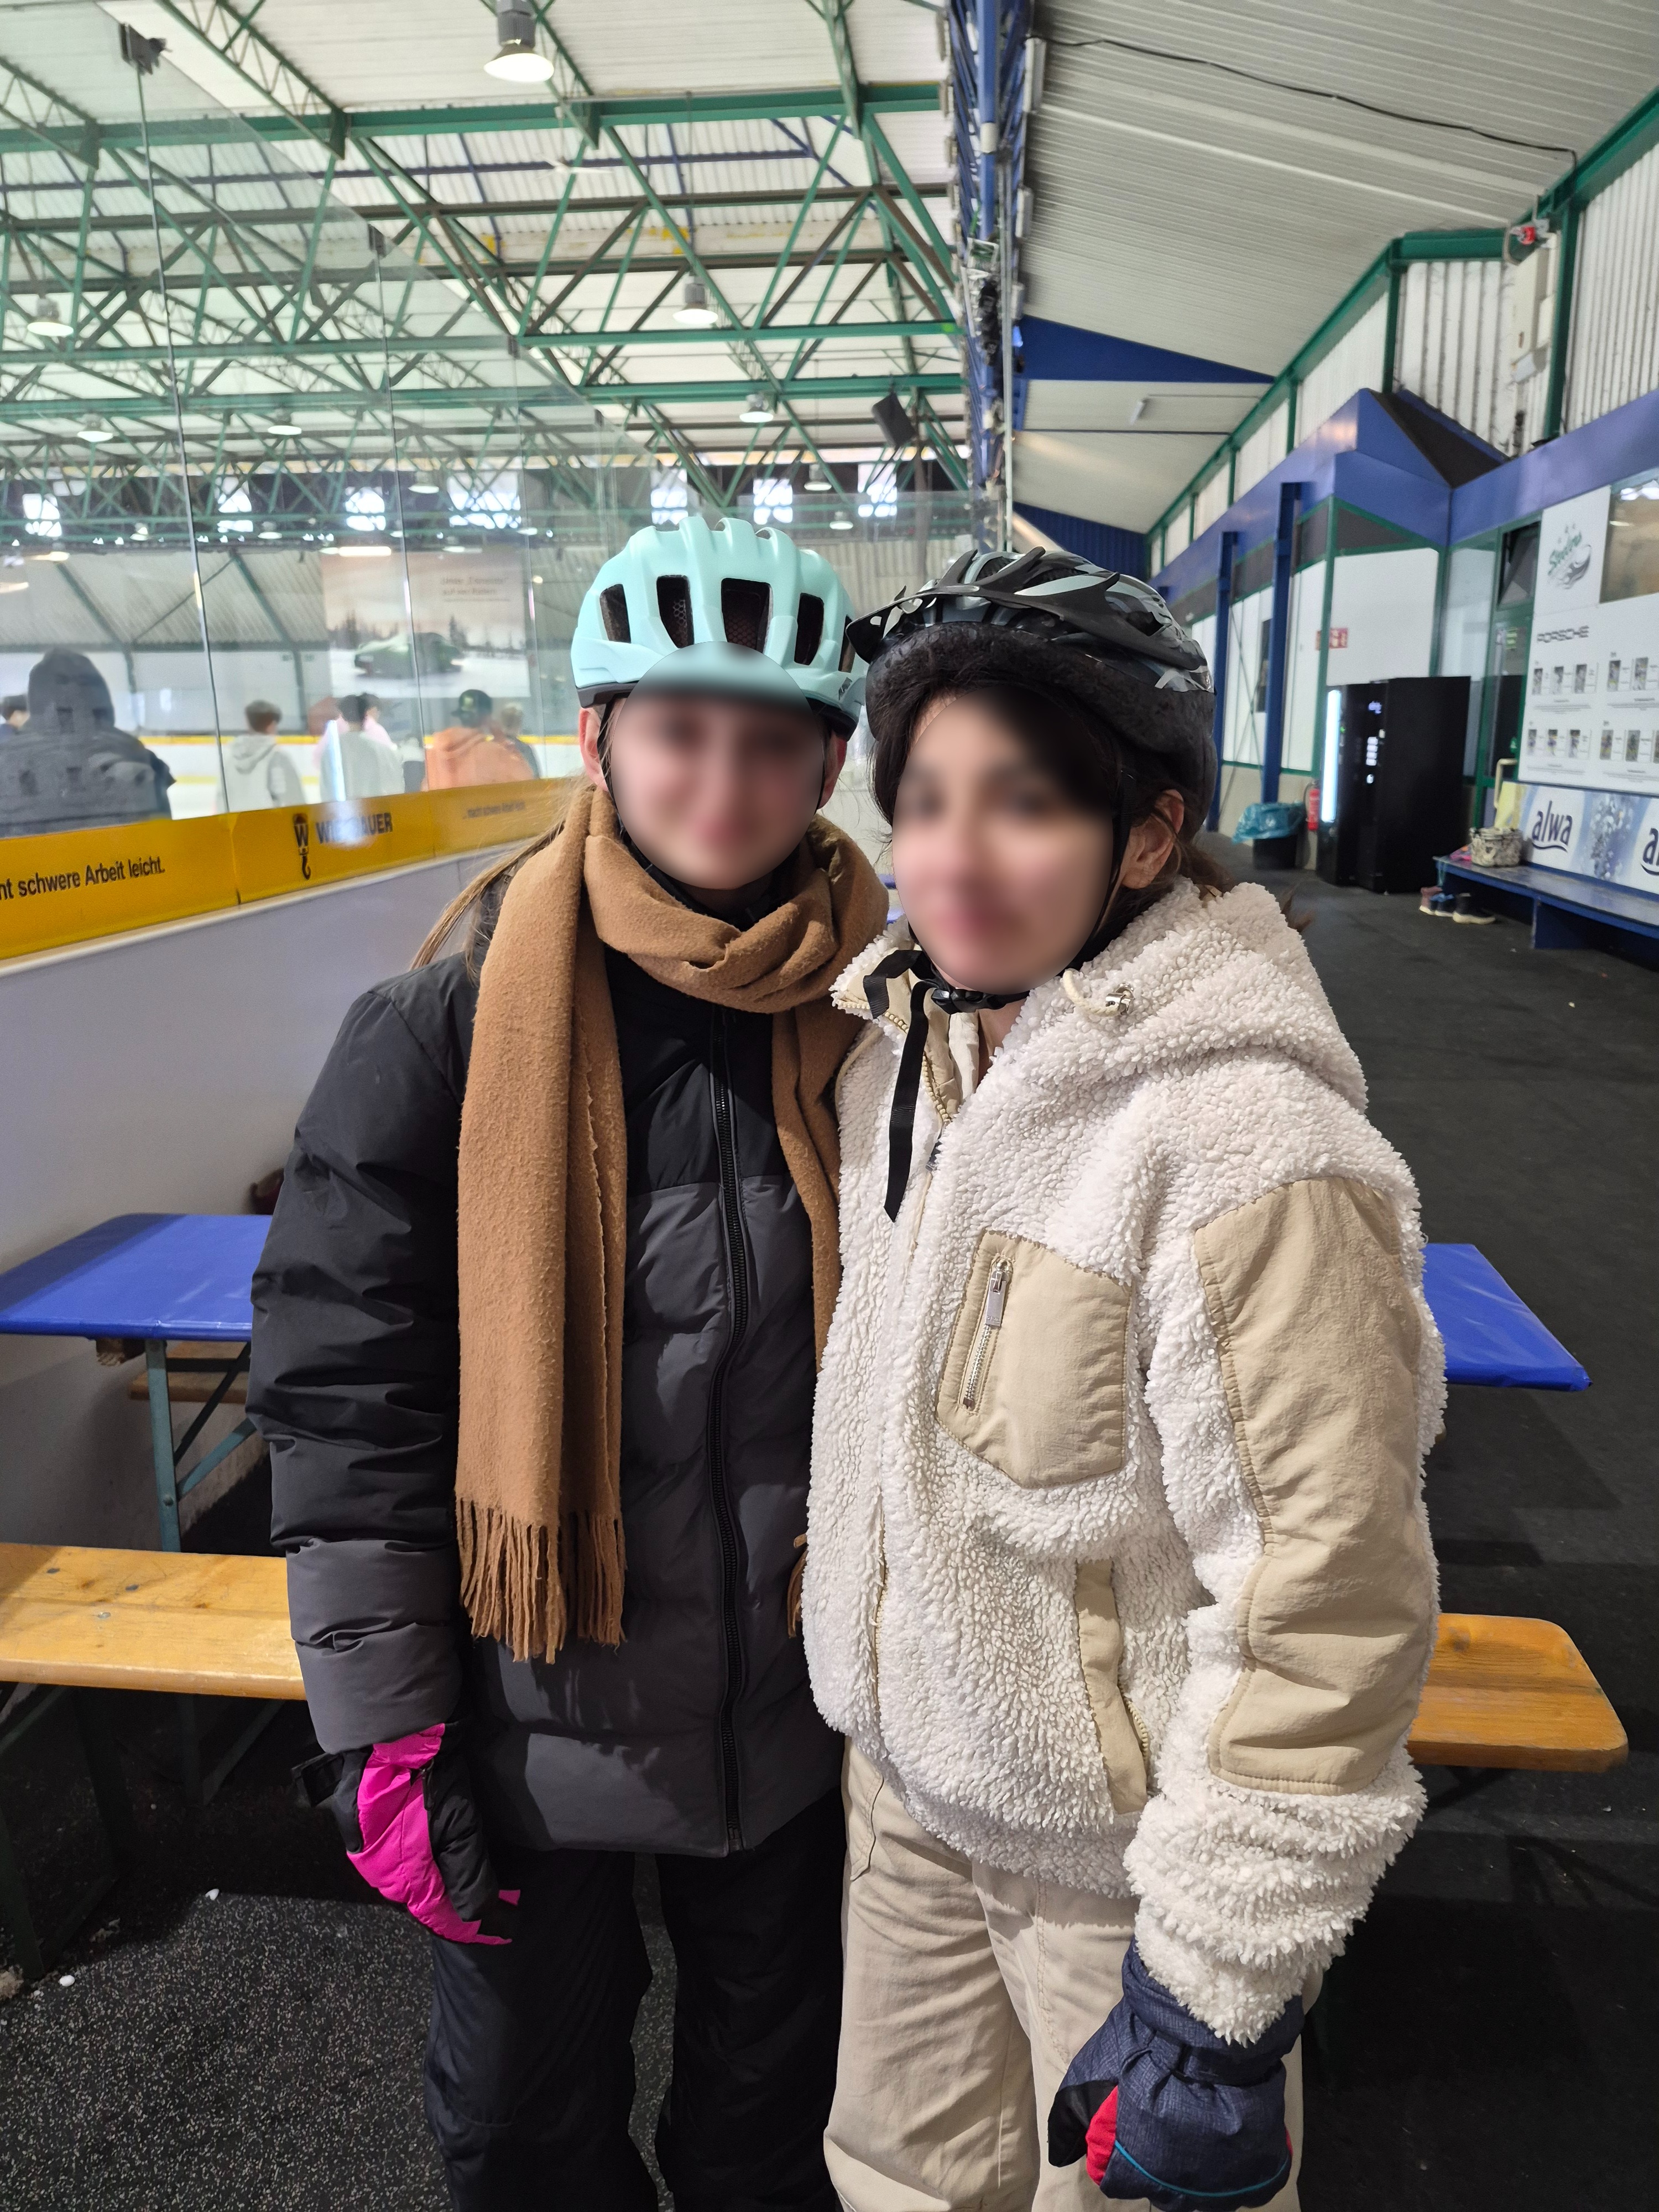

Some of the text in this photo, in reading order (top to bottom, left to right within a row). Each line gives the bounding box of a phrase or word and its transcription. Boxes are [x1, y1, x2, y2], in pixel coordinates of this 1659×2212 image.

[316, 812, 393, 844] WAUER
[1531, 800, 1573, 846] alwa
[1642, 827, 1659, 866] a
[18, 872, 81, 897] schwere
[85, 860, 126, 886] Arbeit
[128, 856, 165, 878] leicht.
